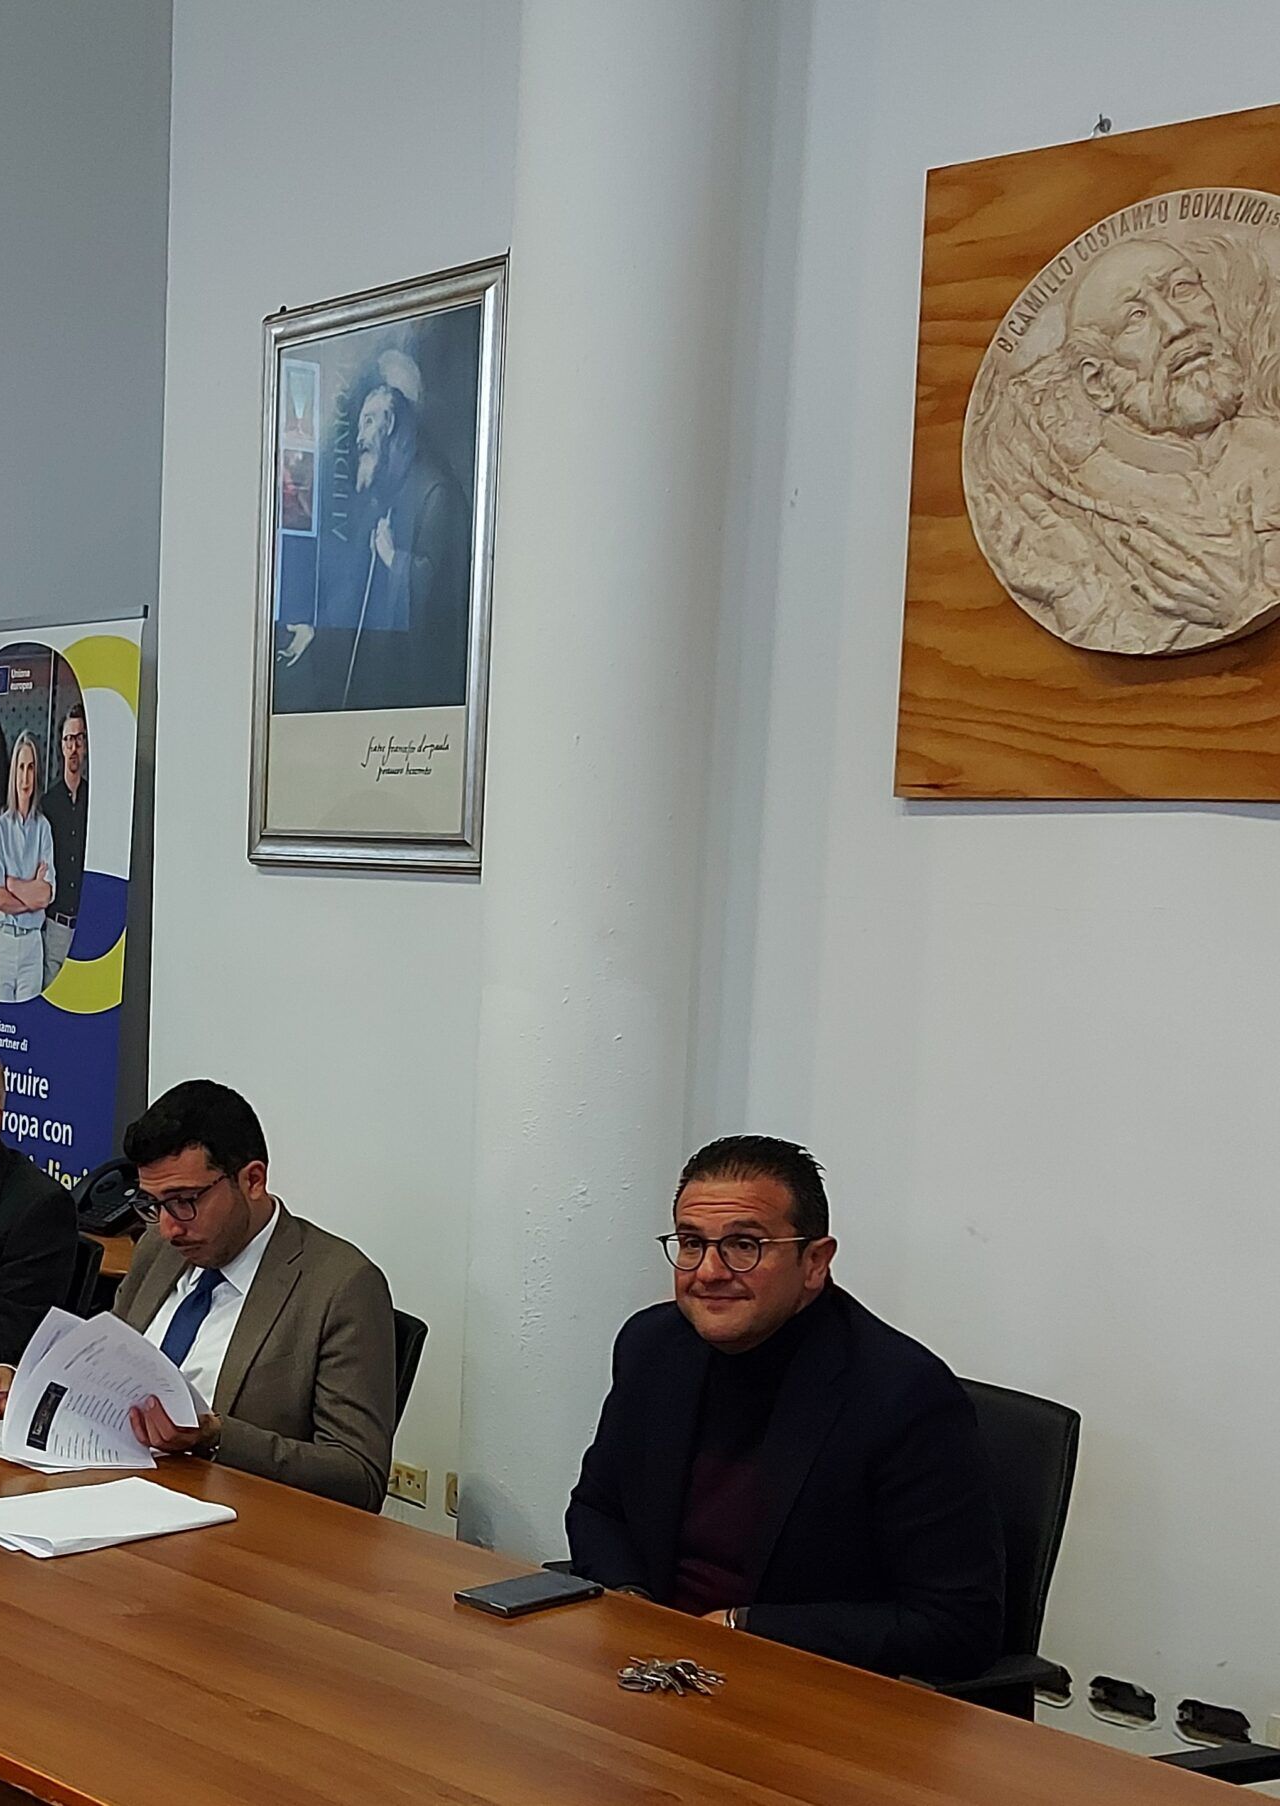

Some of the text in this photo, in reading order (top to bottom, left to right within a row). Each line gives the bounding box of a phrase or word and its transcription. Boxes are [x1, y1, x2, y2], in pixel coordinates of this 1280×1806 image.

[1008, 256, 1074, 337] CAMILLO
[1074, 200, 1168, 262] COSTANZO
[1179, 192, 1268, 225] BOVALINO
[20, 1039, 28, 1051] di
[4, 1066, 49, 1099] truire
[2, 1110, 72, 1146] ropa con
